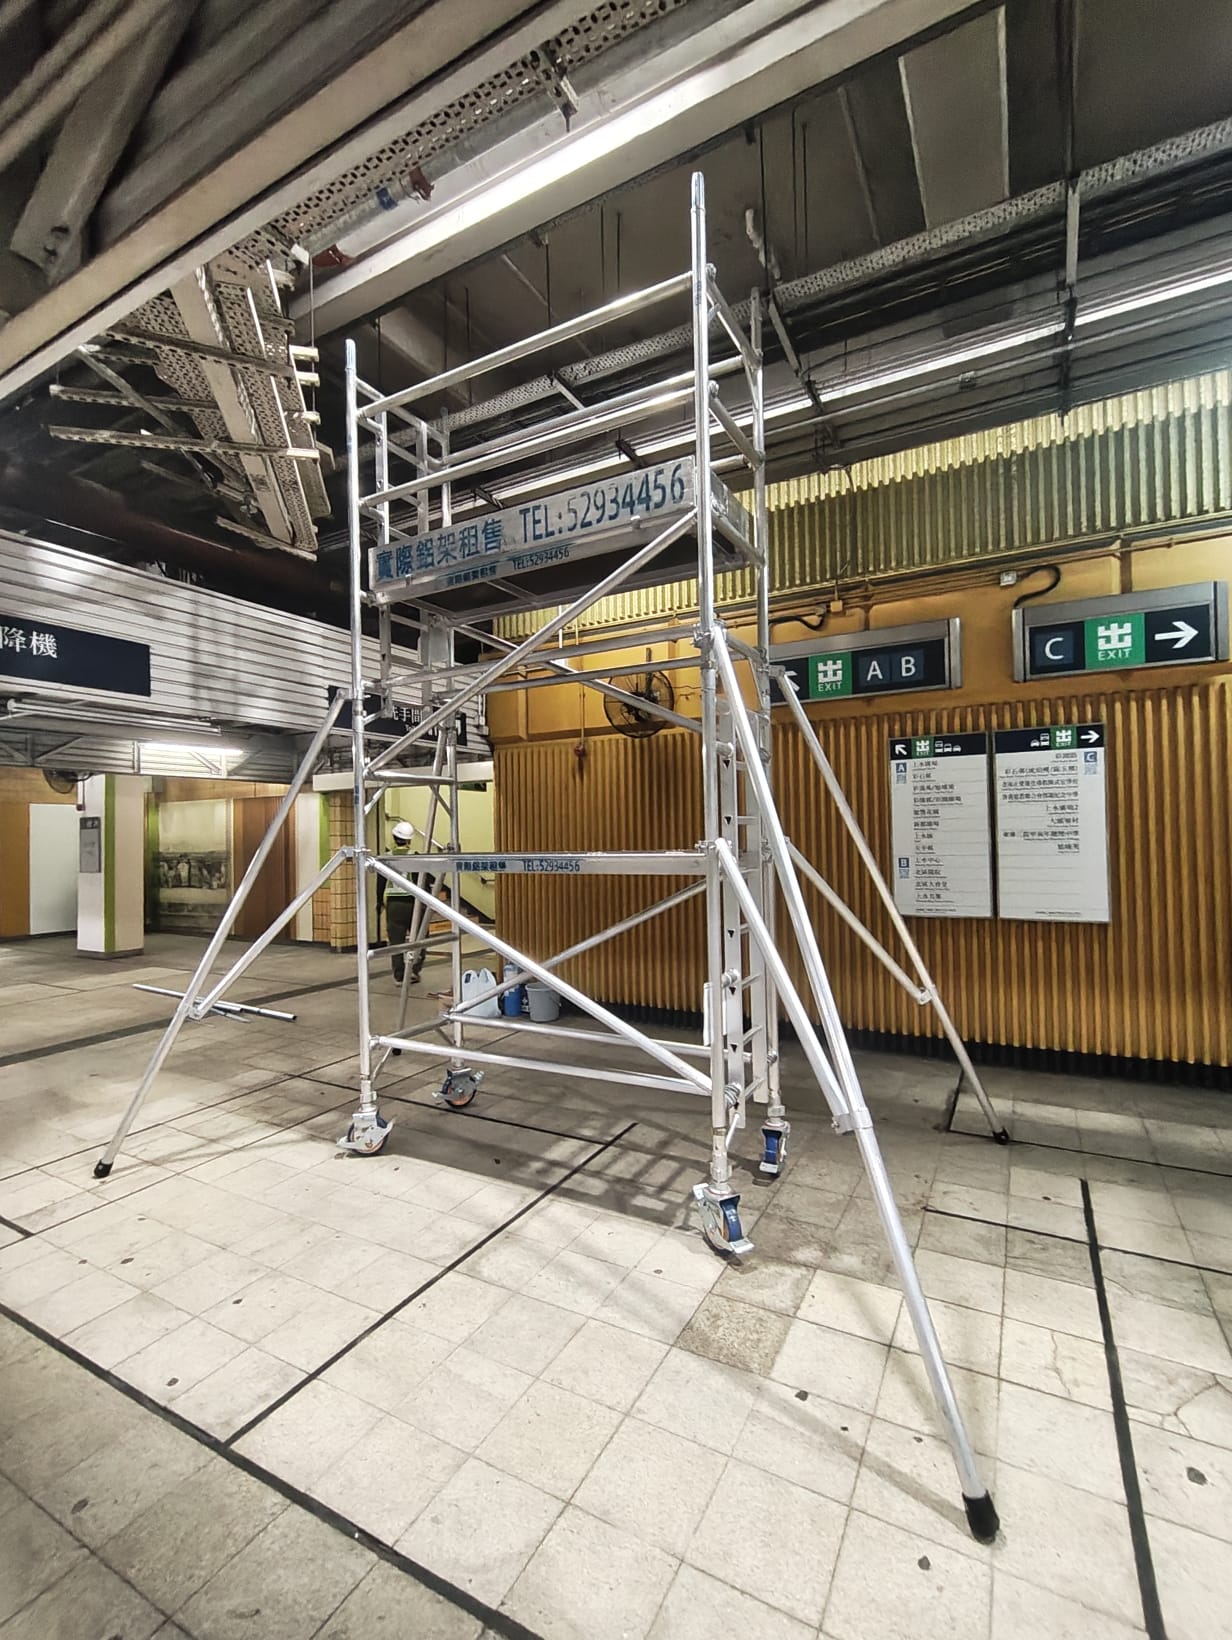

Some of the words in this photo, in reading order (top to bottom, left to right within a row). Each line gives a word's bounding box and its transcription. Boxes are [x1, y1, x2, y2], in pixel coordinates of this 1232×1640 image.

[519, 463, 685, 543] TEL:52934456
[1045, 637, 1064, 660] C
[1098, 648, 1131, 661] EXIT
[867, 660, 883, 681] A
[901, 656, 916, 677] B
[817, 681, 842, 692] EXIT
[1086, 752, 1096, 762] C
[898, 764, 905, 772] A
[901, 859, 908, 867] B
